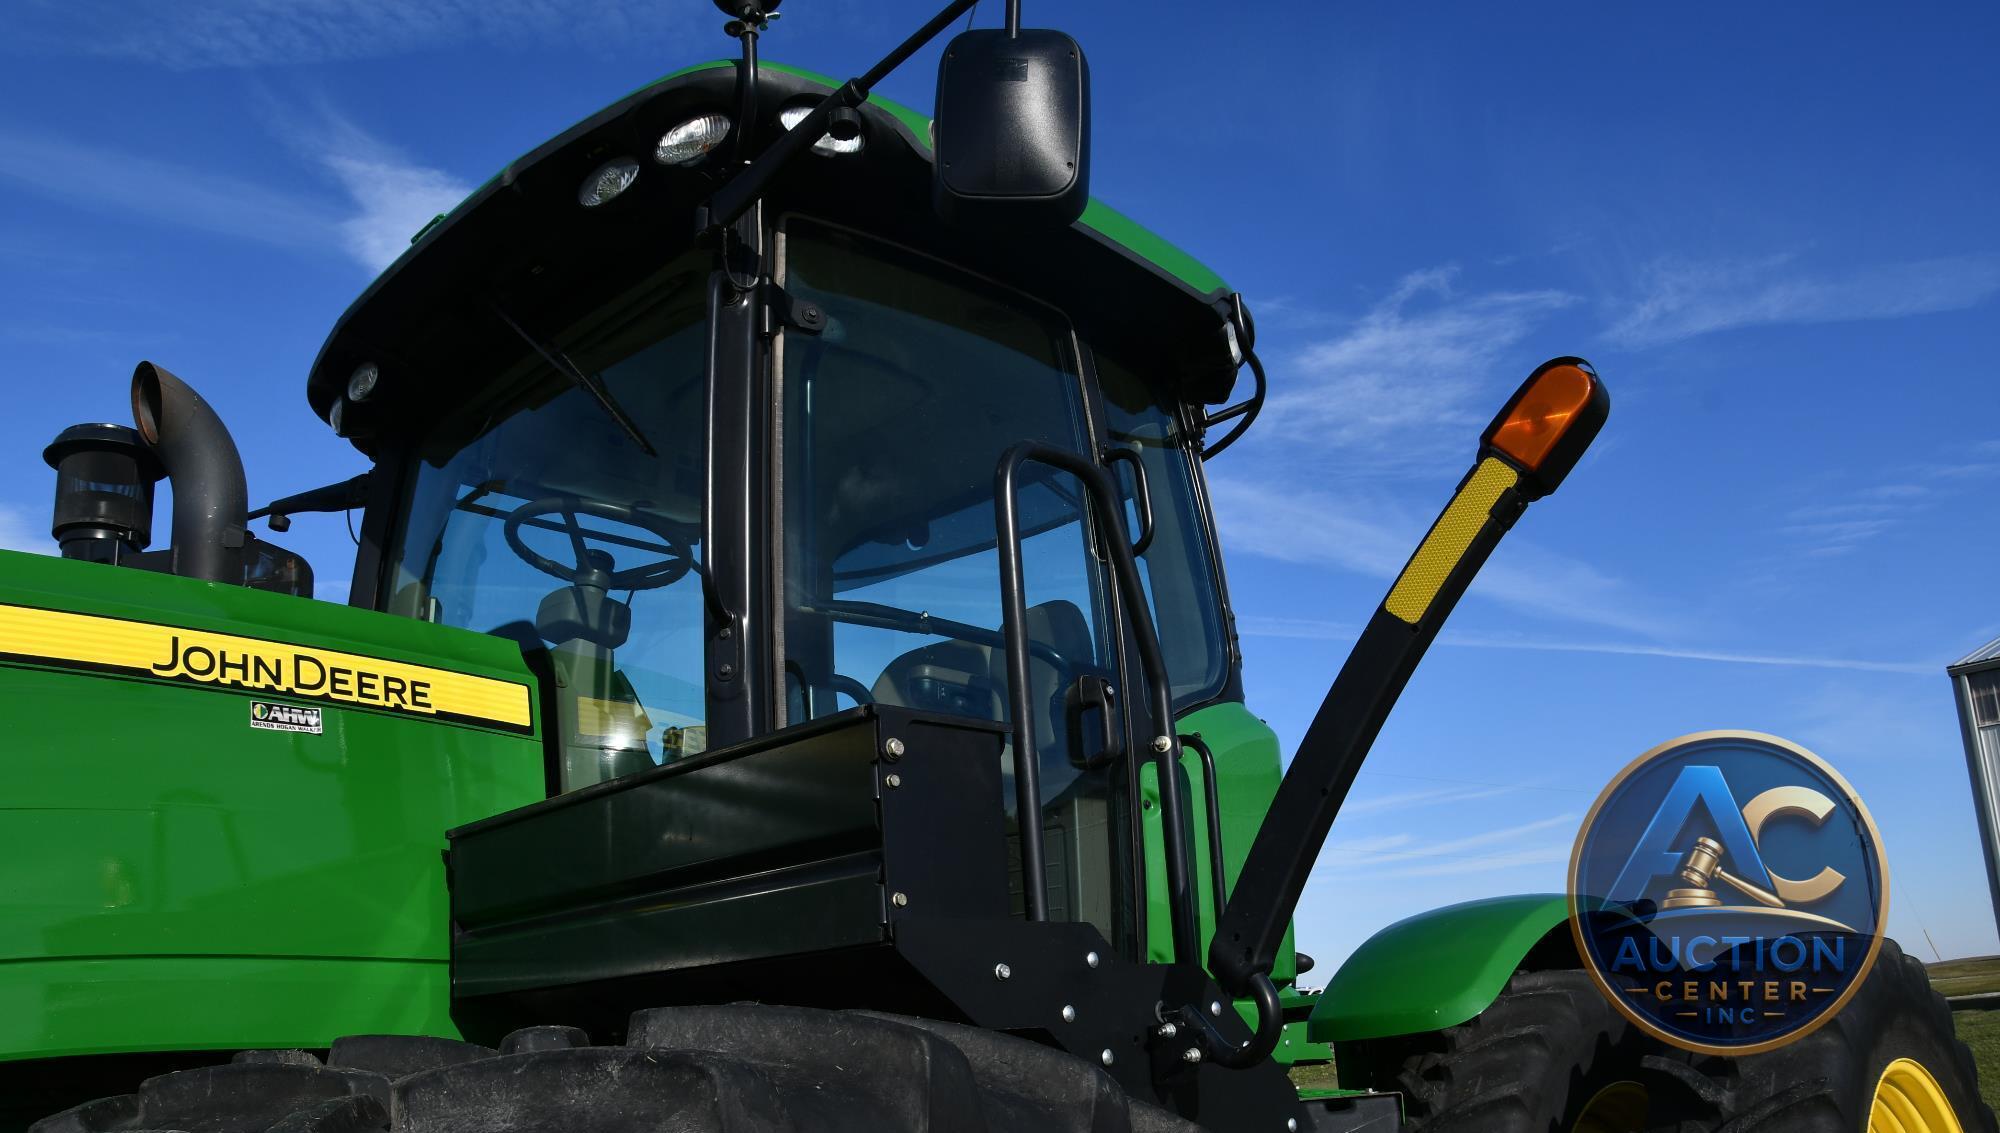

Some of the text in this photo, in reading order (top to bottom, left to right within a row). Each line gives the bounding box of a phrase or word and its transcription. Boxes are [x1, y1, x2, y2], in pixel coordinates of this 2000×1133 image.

[153, 636, 432, 708] JOHN DEERE
[268, 706, 319, 726] AHW
